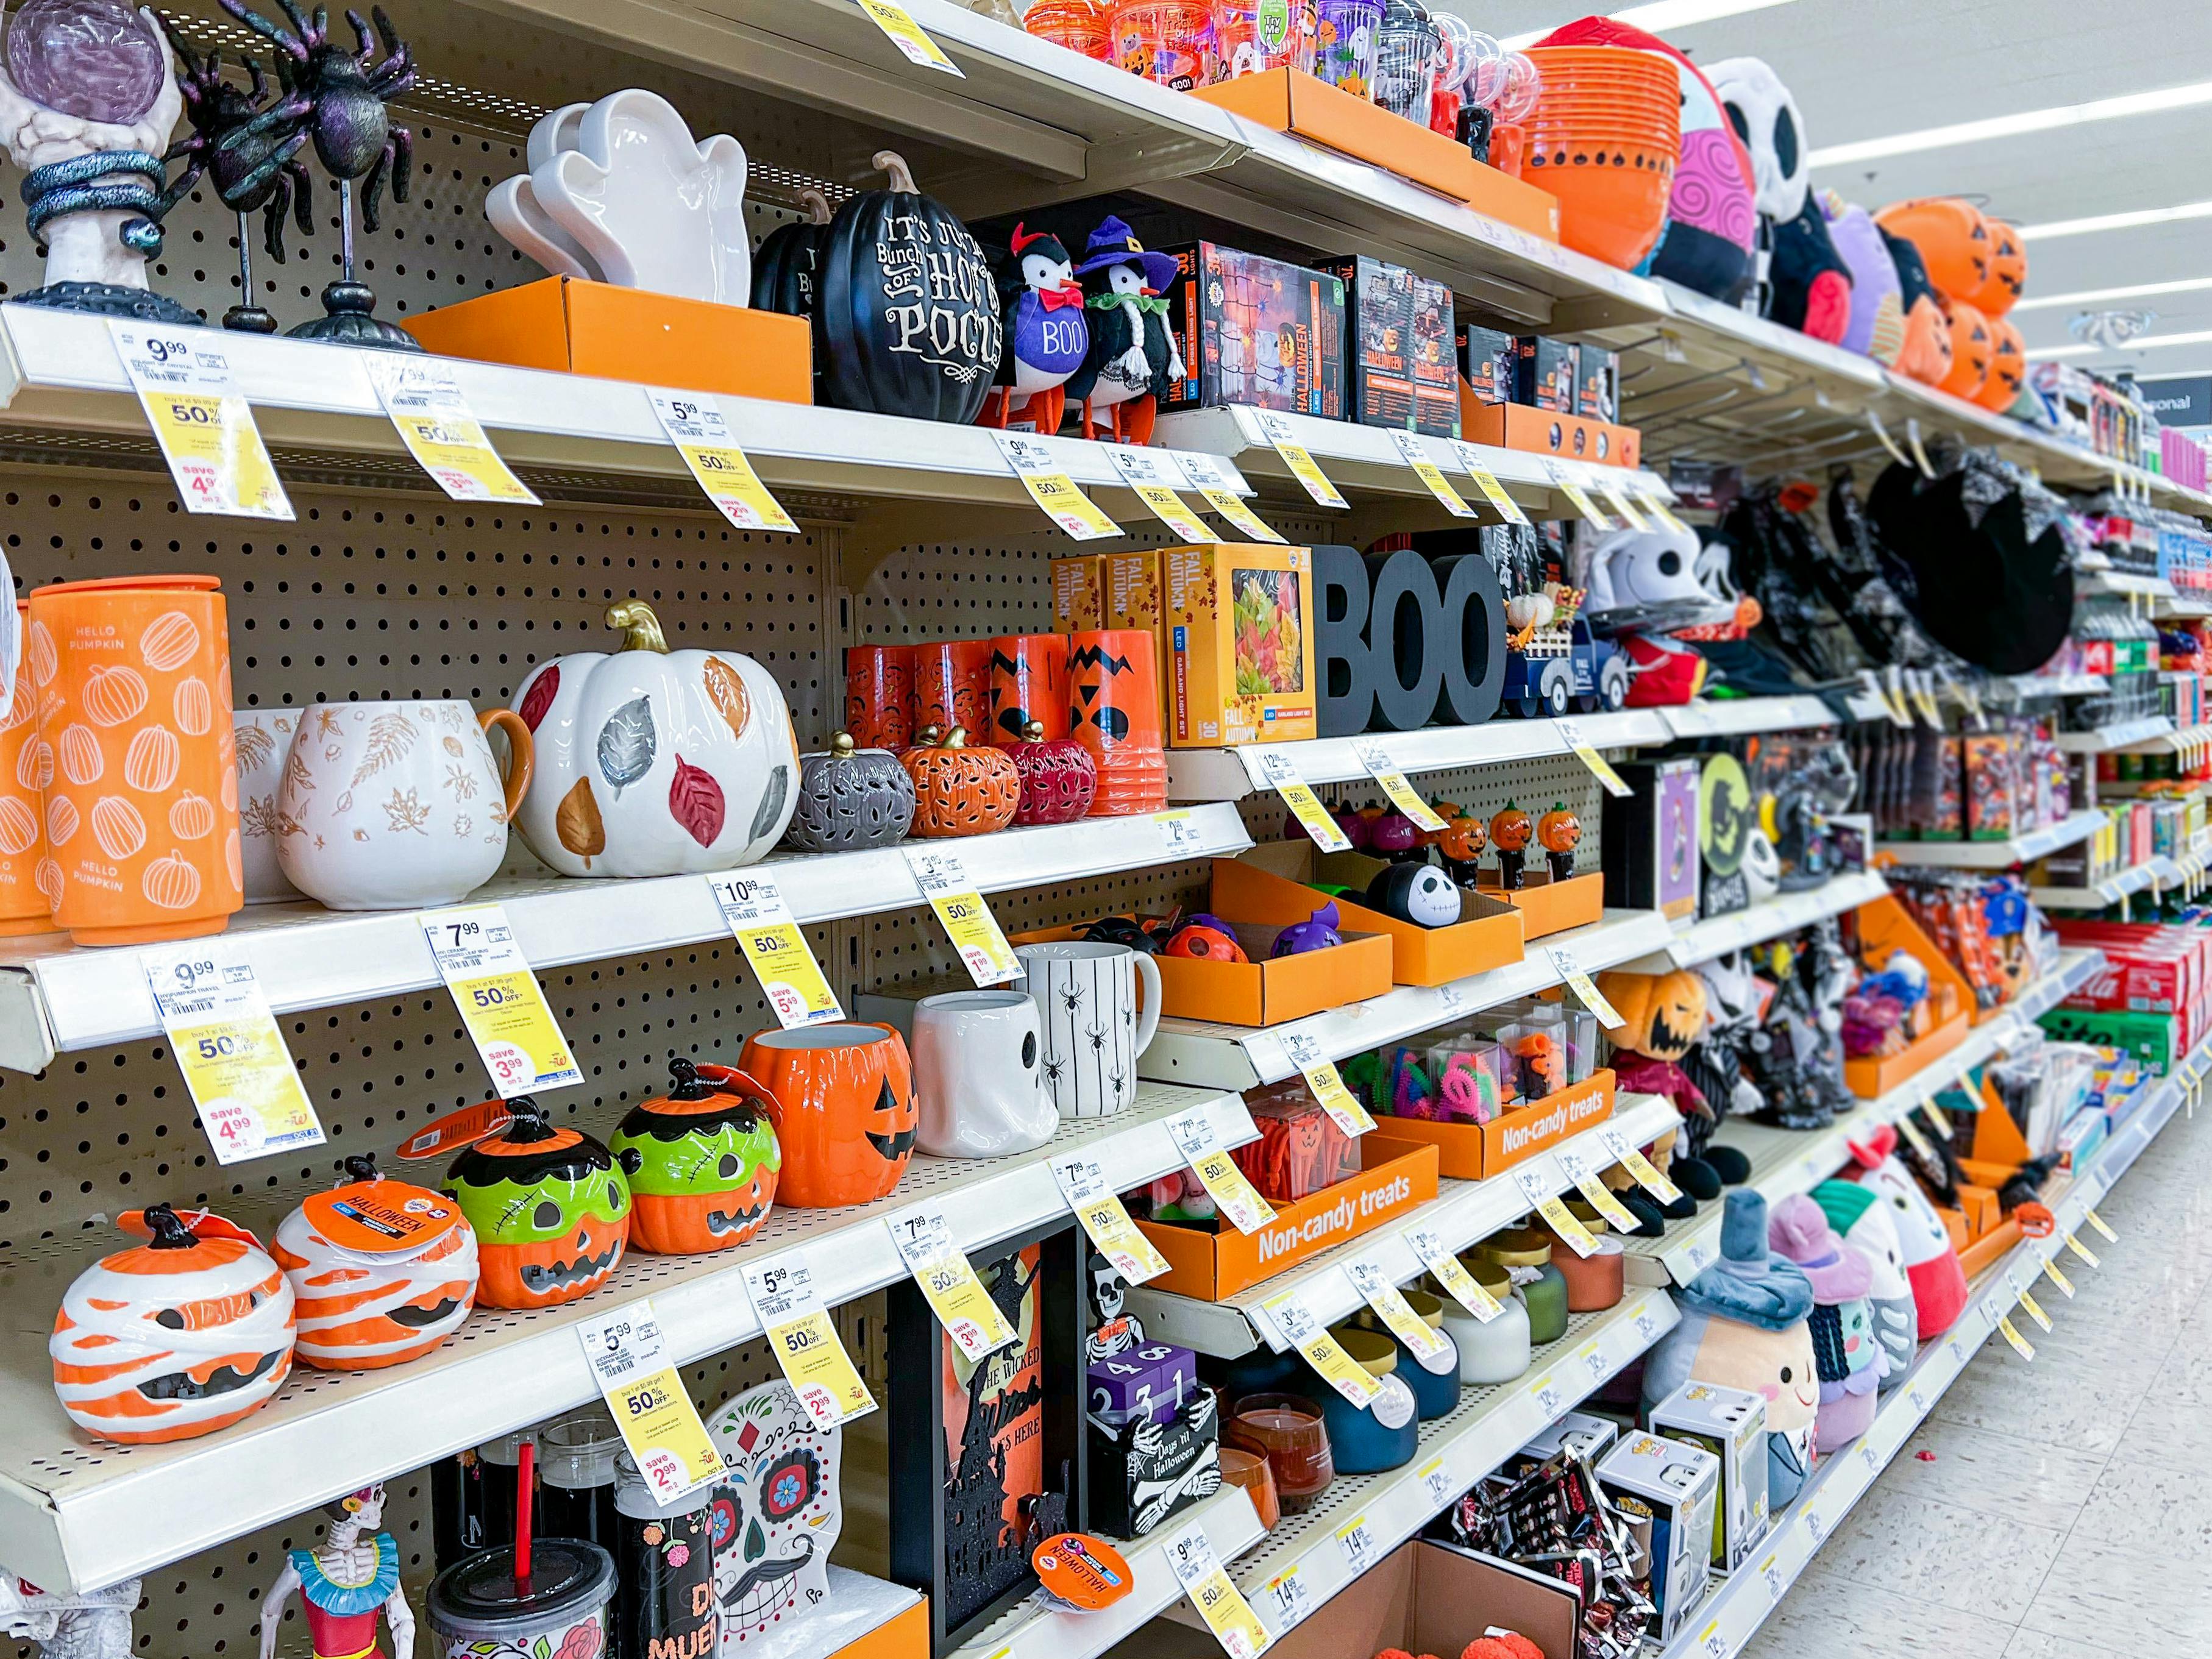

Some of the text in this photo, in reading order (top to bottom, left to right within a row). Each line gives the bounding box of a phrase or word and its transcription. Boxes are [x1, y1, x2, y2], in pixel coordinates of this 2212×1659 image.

[1264, 15, 1281, 27] Try
[1265, 25, 1281, 34] Me
[1172, 79, 1191, 90] BOO!
[884, 215, 931, 244] IT'S
[876, 243, 923, 266] Bunch
[892, 273, 912, 288] OF
[1042, 320, 1083, 354] BOO
[1295, 323, 1308, 413] HALLOWEEN
[1367, 350, 1403, 371] HALLOWEEN
[183, 466, 215, 475] save
[1070, 563, 1084, 595] FALL
[1128, 557, 1142, 591] FALL
[1184, 551, 1201, 586] FALL
[1056, 564, 1070, 617] AUTUMN
[1113, 558, 1127, 616] AUTUMN
[1170, 553, 1185, 609] AUTUMN
[76, 625, 116, 637] HELLO
[1312, 544, 1507, 737] BOO
[69, 639, 124, 651] PUMPKIN
[1225, 709, 1244, 726] FALL
[1202, 721, 1218, 739] 30
[1225, 726, 1256, 742] AUTUMN
[81, 859, 118, 878] HELLO
[73, 869, 123, 893] PUMPKIN
[755, 936, 785, 952] 50%
[473, 986, 514, 1007] 50%
[771, 988, 791, 997] save
[489, 1048, 514, 1060] save
[210, 1107, 243, 1120] save
[1501, 1090, 1603, 1156] Non-candy treats
[336, 1204, 352, 1213] LED
[346, 1196, 426, 1232] HALLOWEEN
[1258, 1174, 1411, 1263] Non-candy treats
[363, 1217, 397, 1234] CHARACTER
[764, 1268, 787, 1293] 599
[954, 1321, 970, 1334] save
[785, 1328, 816, 1351] 50%
[983, 1346, 1039, 1391] HE WICKED
[1106, 1346, 1172, 1375] 4 8
[627, 1387, 663, 1415] 50%
[803, 1388, 822, 1401] save
[980, 1374, 1042, 1438] Witch
[1093, 1387, 1112, 1413] 2
[1136, 1369, 1184, 1423] 3 1
[1014, 1416, 1040, 1446] HERE
[645, 1454, 668, 1469] save
[1158, 1440, 1178, 1460] Days
[1153, 1446, 1195, 1479] Halloween
[1049, 1545, 1108, 1593] HALLOWEEN
[1106, 1574, 1117, 1582] LED
